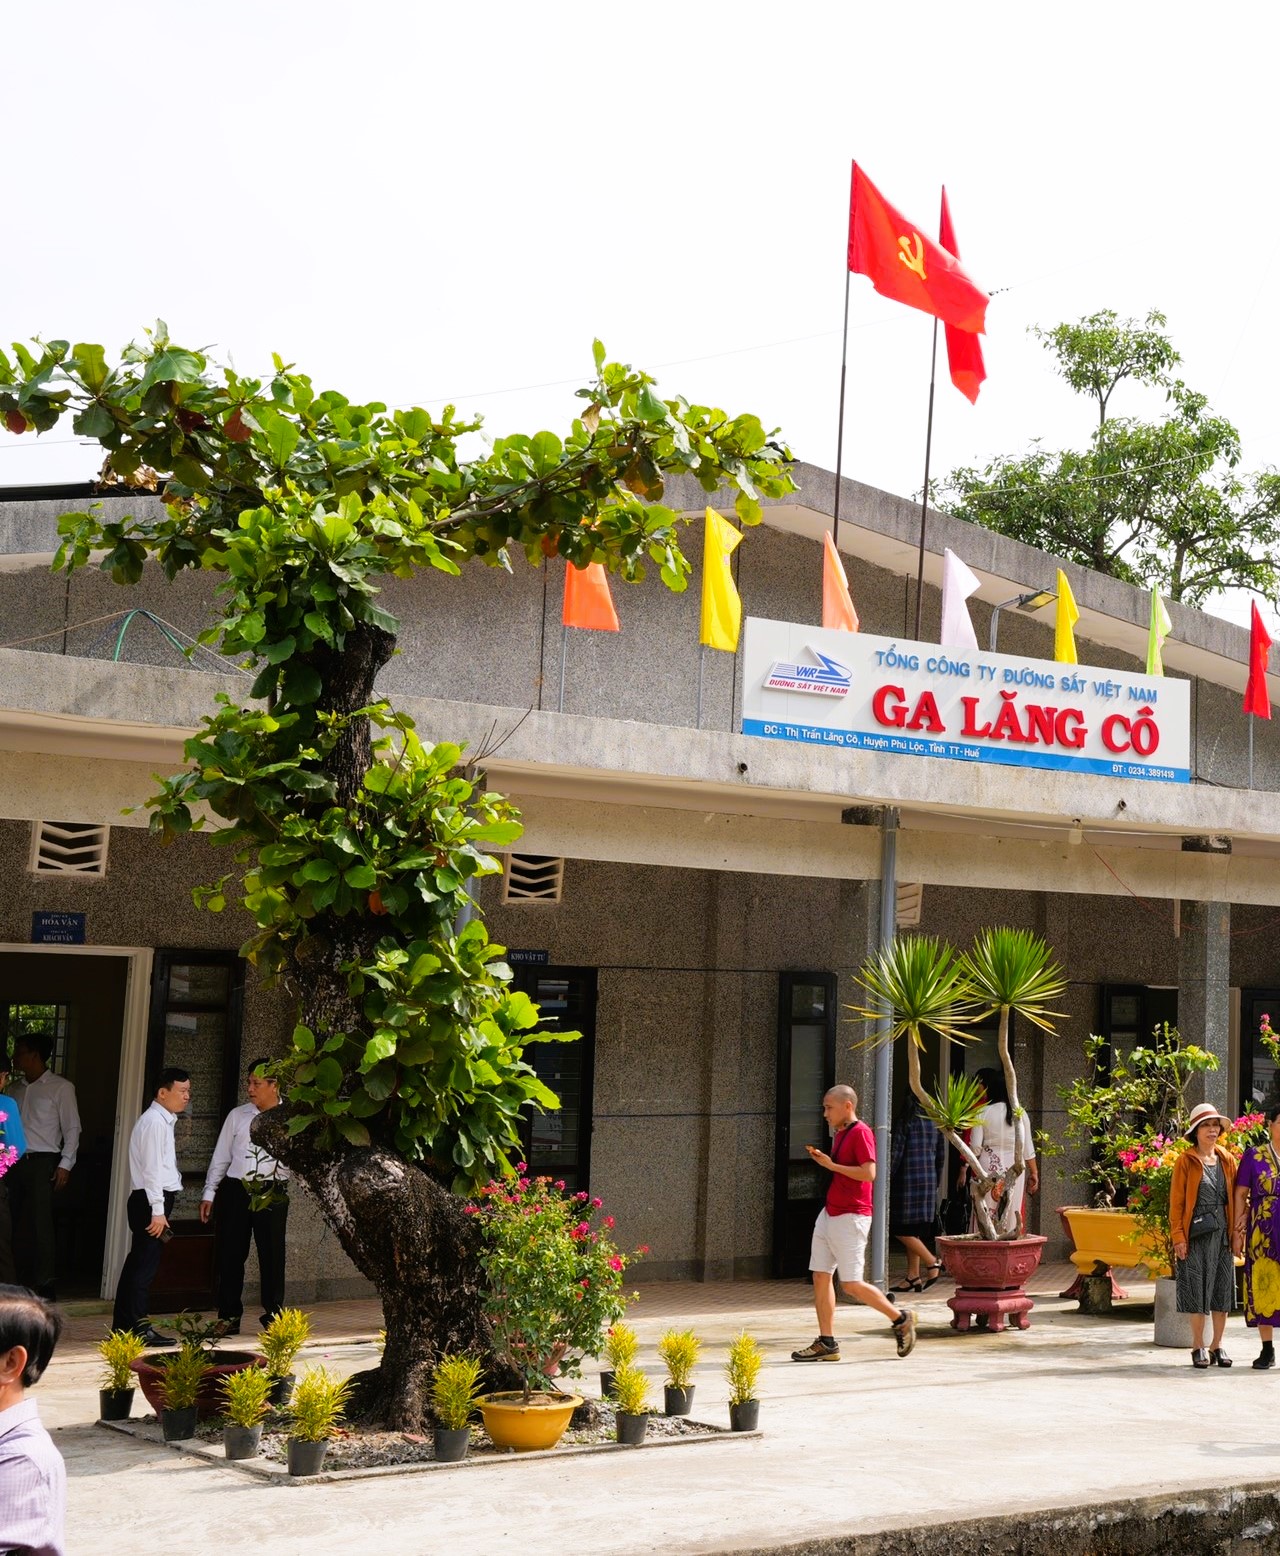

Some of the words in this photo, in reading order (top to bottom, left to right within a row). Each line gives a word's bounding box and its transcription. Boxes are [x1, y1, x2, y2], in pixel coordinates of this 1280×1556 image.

[796, 666, 818, 678] VNR
[876, 643, 919, 671] TỔNG
[926, 655, 970, 677] CÔNG
[978, 665, 996, 680] TY
[1004, 667, 1054, 689] ĐƯỜNG
[1061, 672, 1087, 693] SẮT
[1093, 679, 1122, 702] VIỆT
[1128, 686, 1157, 703] NAM
[830, 687, 848, 695] NAM
[872, 684, 946, 732] GA
[960, 690, 1088, 749] LĂNG
[1101, 706, 1160, 756] CÔ
[764, 725, 782, 734] ĐC:
[785, 727, 799, 739] Thị
[802, 728, 821, 740] Trấn
[823, 731, 844, 744] Lăng
[863, 736, 888, 748] Huyện
[891, 739, 907, 749] Phú
[510, 953, 525, 961] KHO
